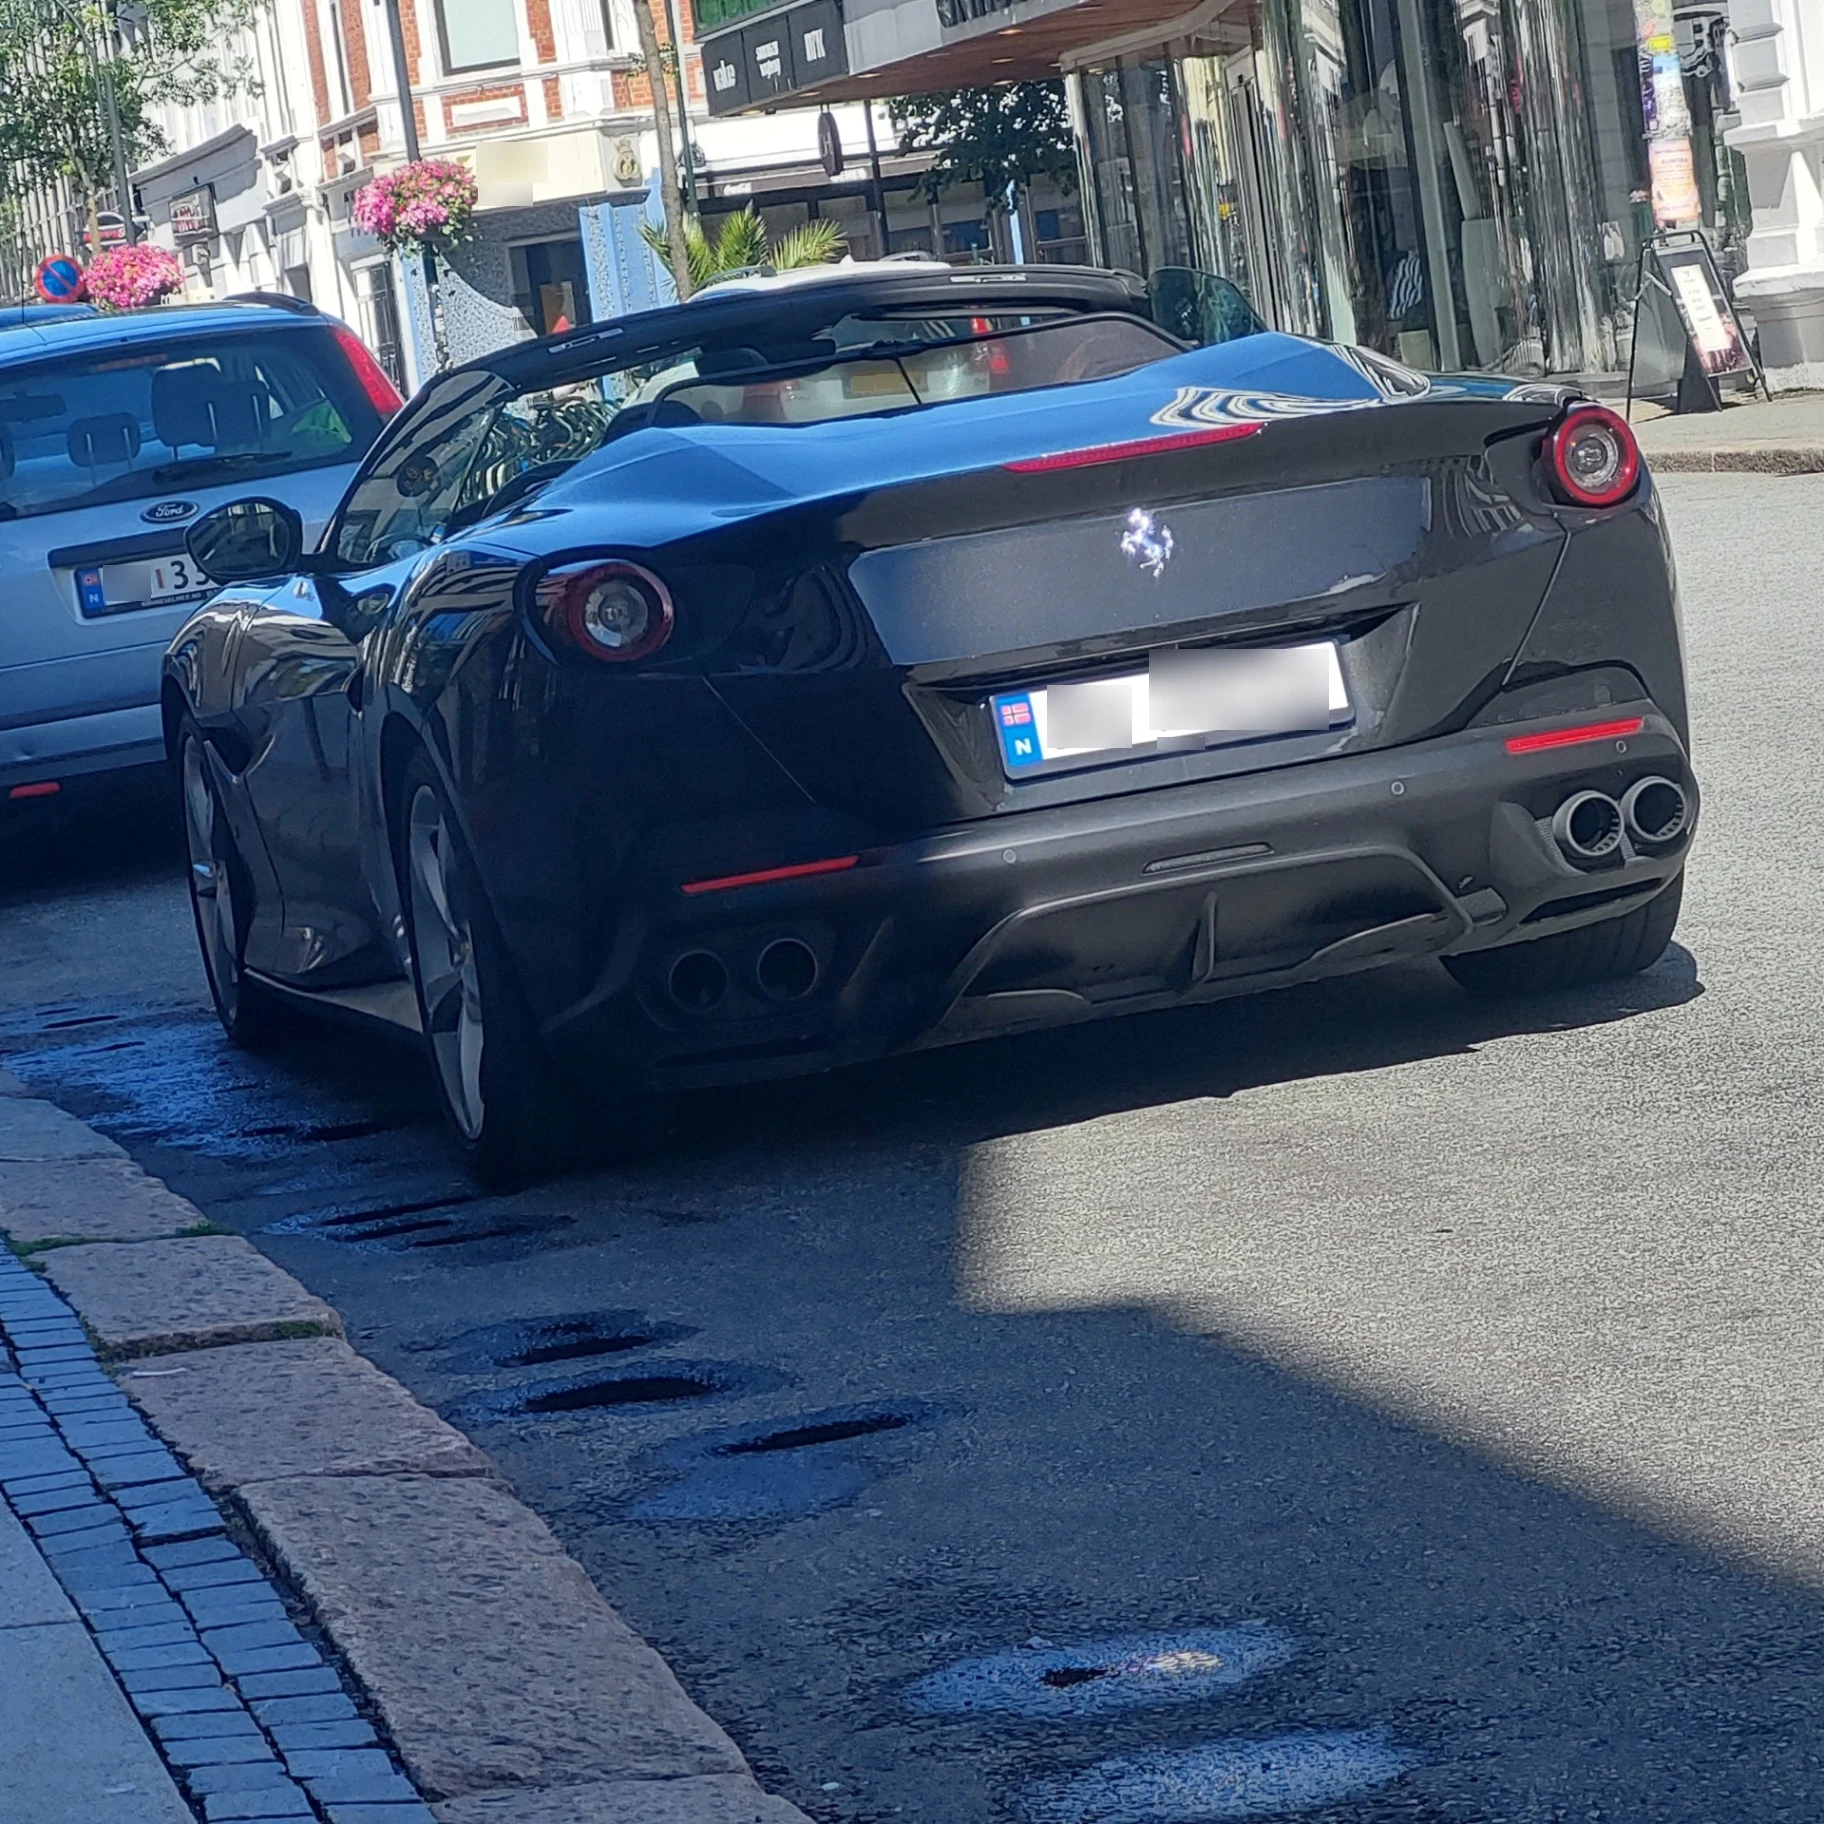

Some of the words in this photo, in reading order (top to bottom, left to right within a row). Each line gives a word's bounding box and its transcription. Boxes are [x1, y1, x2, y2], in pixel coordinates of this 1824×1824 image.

[155, 503, 184, 518] Ford
[89, 593, 99, 604] N
[1015, 738, 1032, 755] N
